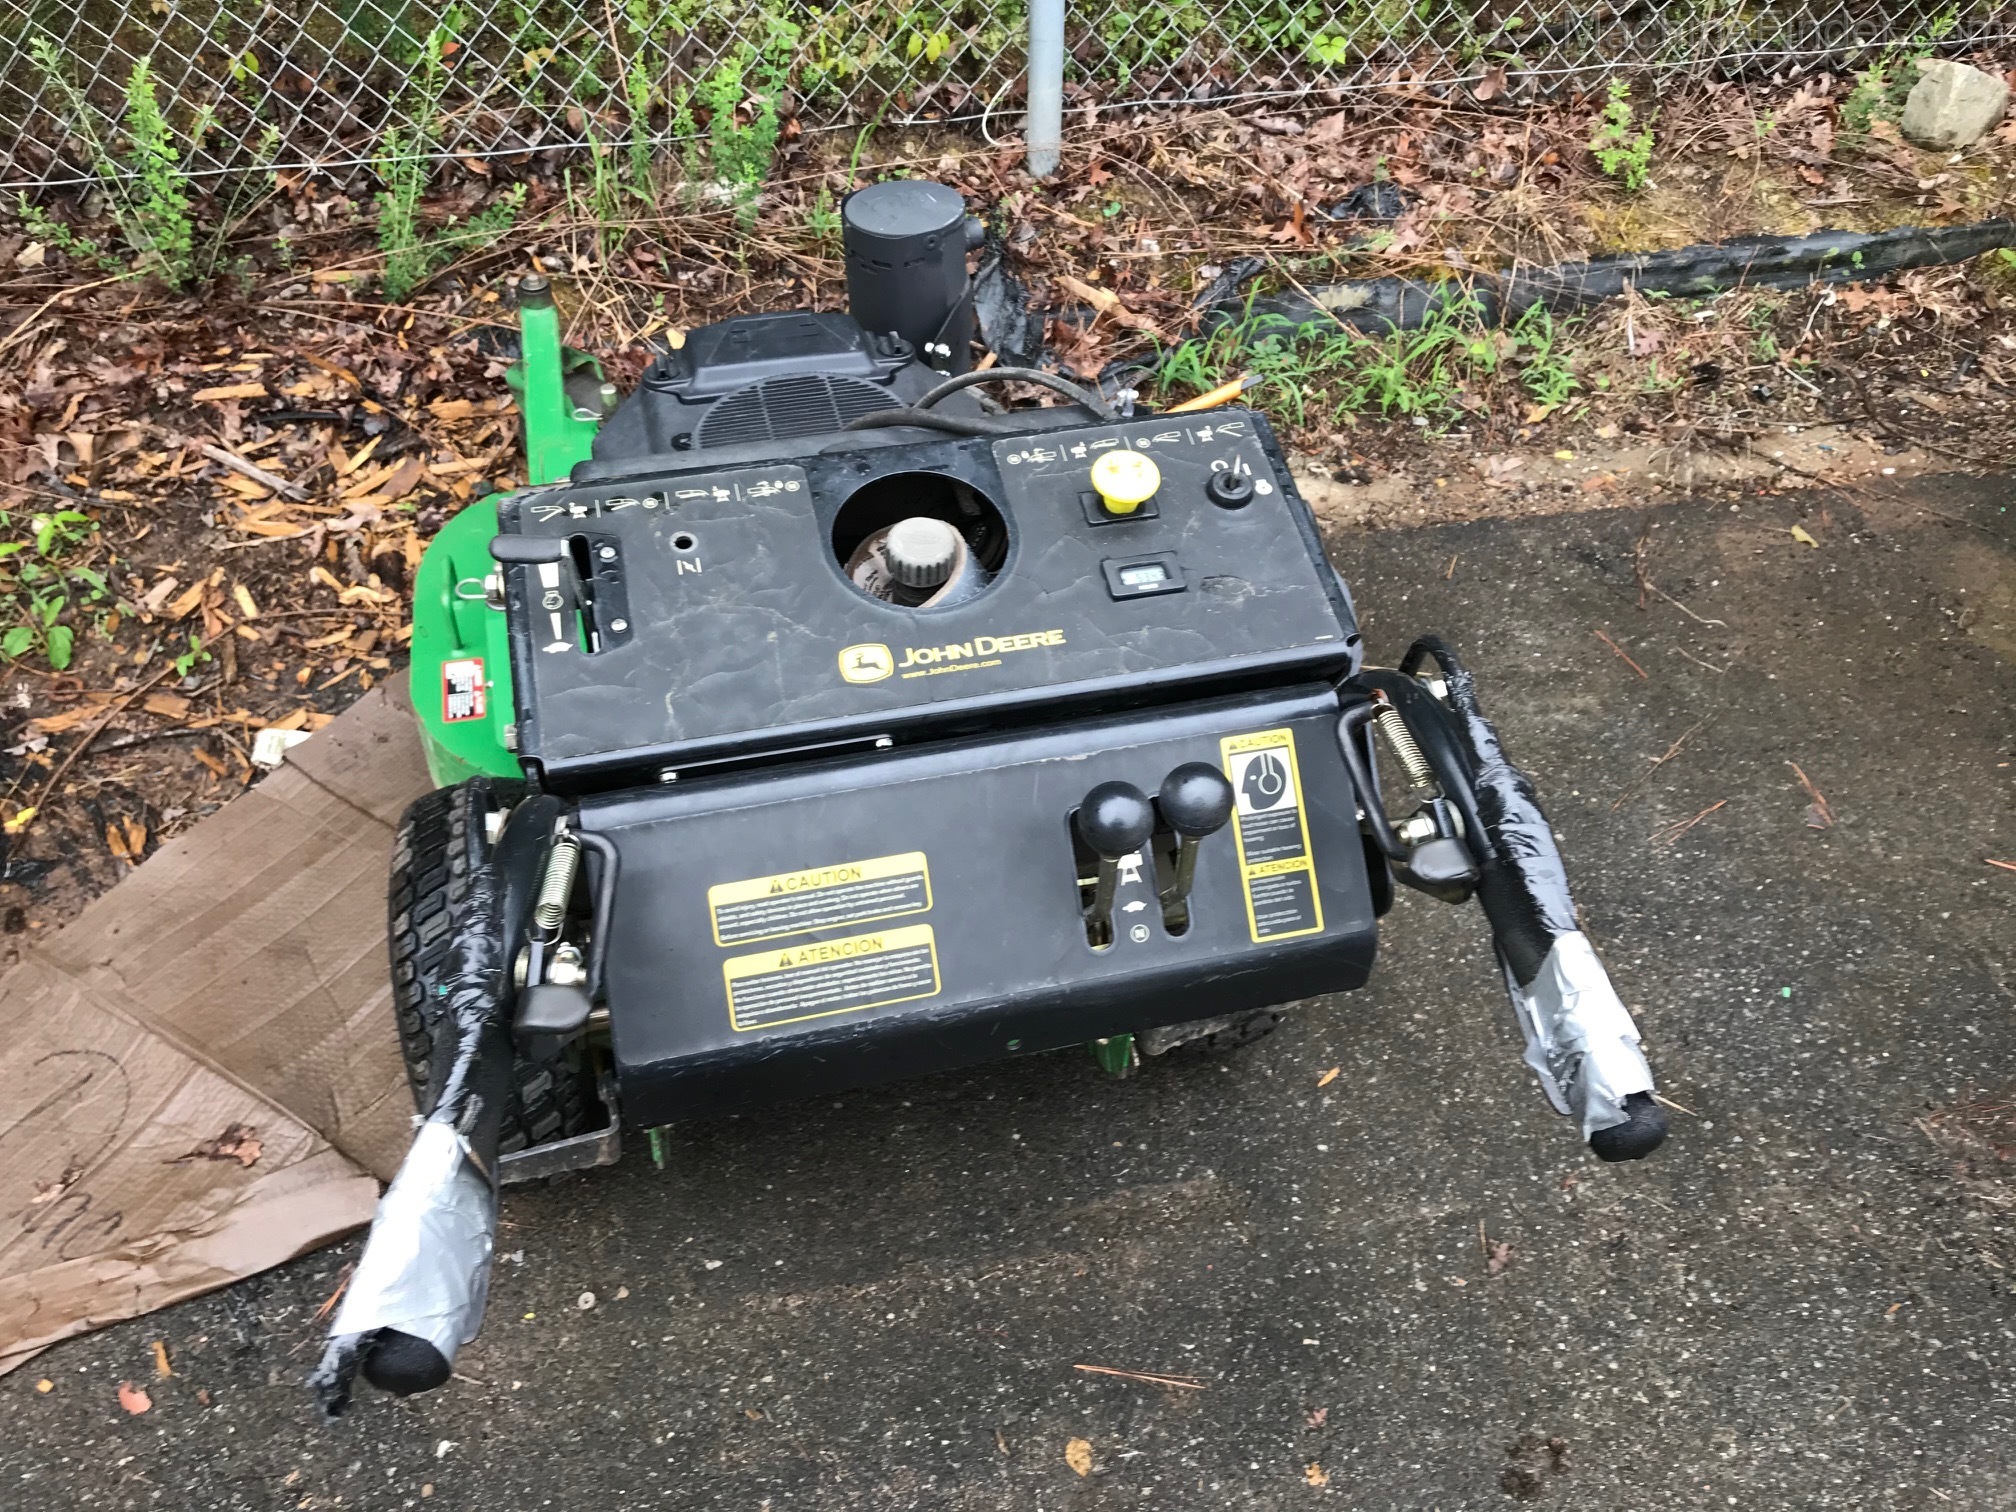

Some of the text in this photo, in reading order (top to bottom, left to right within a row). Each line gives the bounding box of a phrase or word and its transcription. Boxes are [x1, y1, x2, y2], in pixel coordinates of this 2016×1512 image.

[898, 629, 1067, 668] JOHN DEERE
[901, 659, 1002, 679] www.JohnDeere.com
[1240, 734, 1288, 749] CAUTION
[1259, 860, 1308, 874] ATENCION
[786, 867, 861, 891] CAUTION
[798, 938, 883, 963] ATENCION
